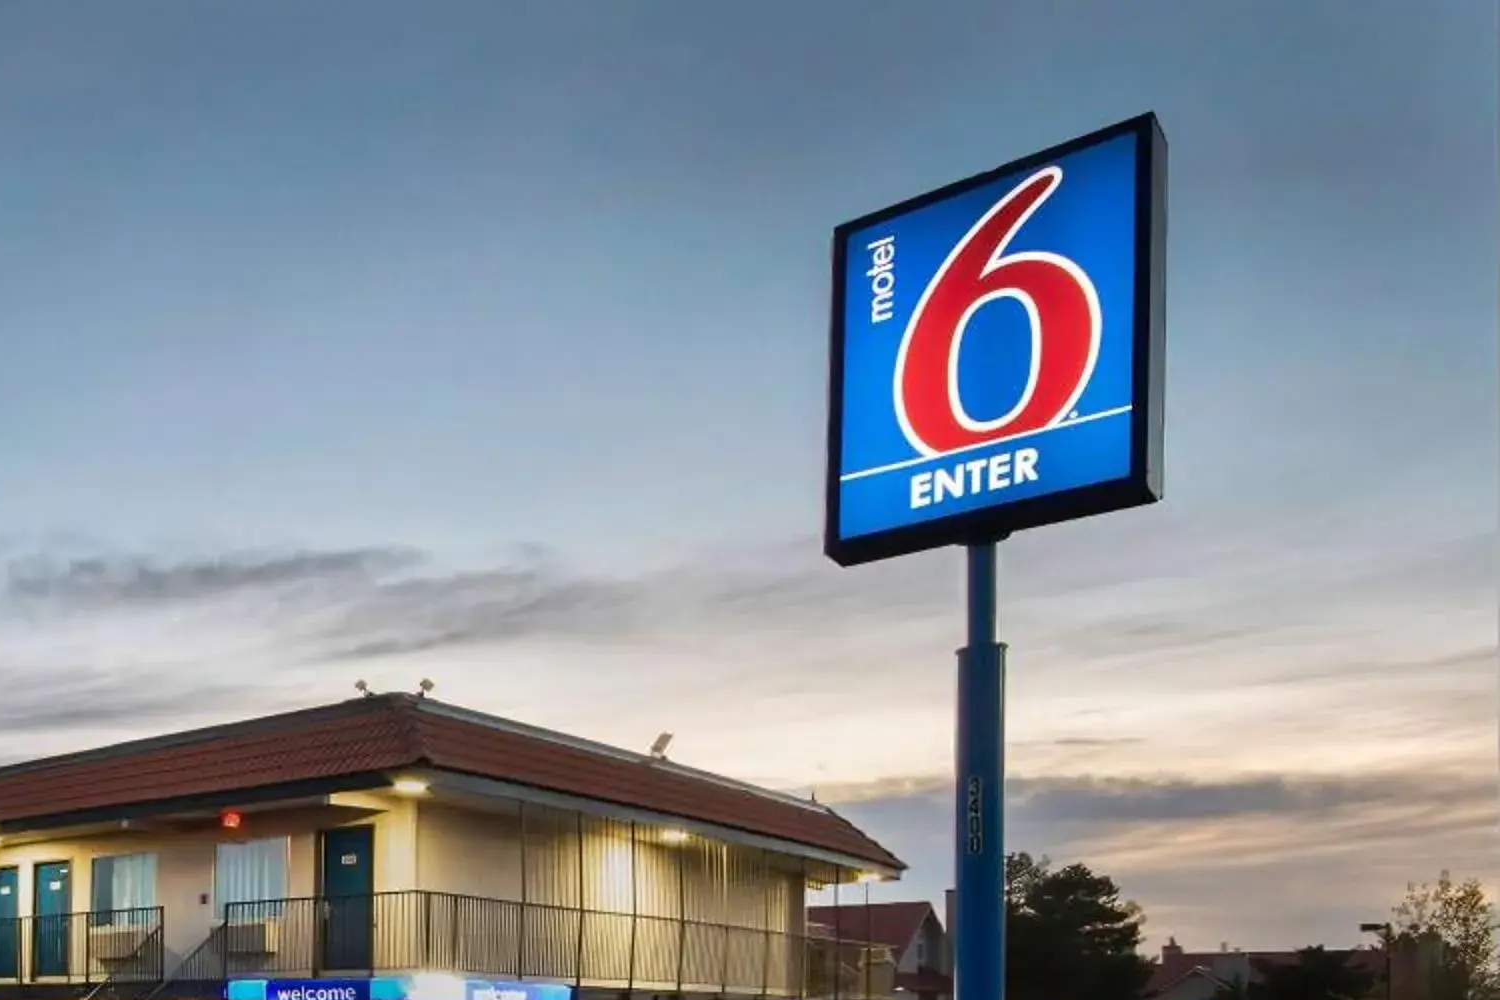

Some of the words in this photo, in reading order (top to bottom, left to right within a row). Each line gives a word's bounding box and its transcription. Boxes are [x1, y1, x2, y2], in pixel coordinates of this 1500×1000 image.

[866, 235, 895, 324] motel
[893, 165, 1102, 459] 6
[910, 447, 1039, 509] ENTER
